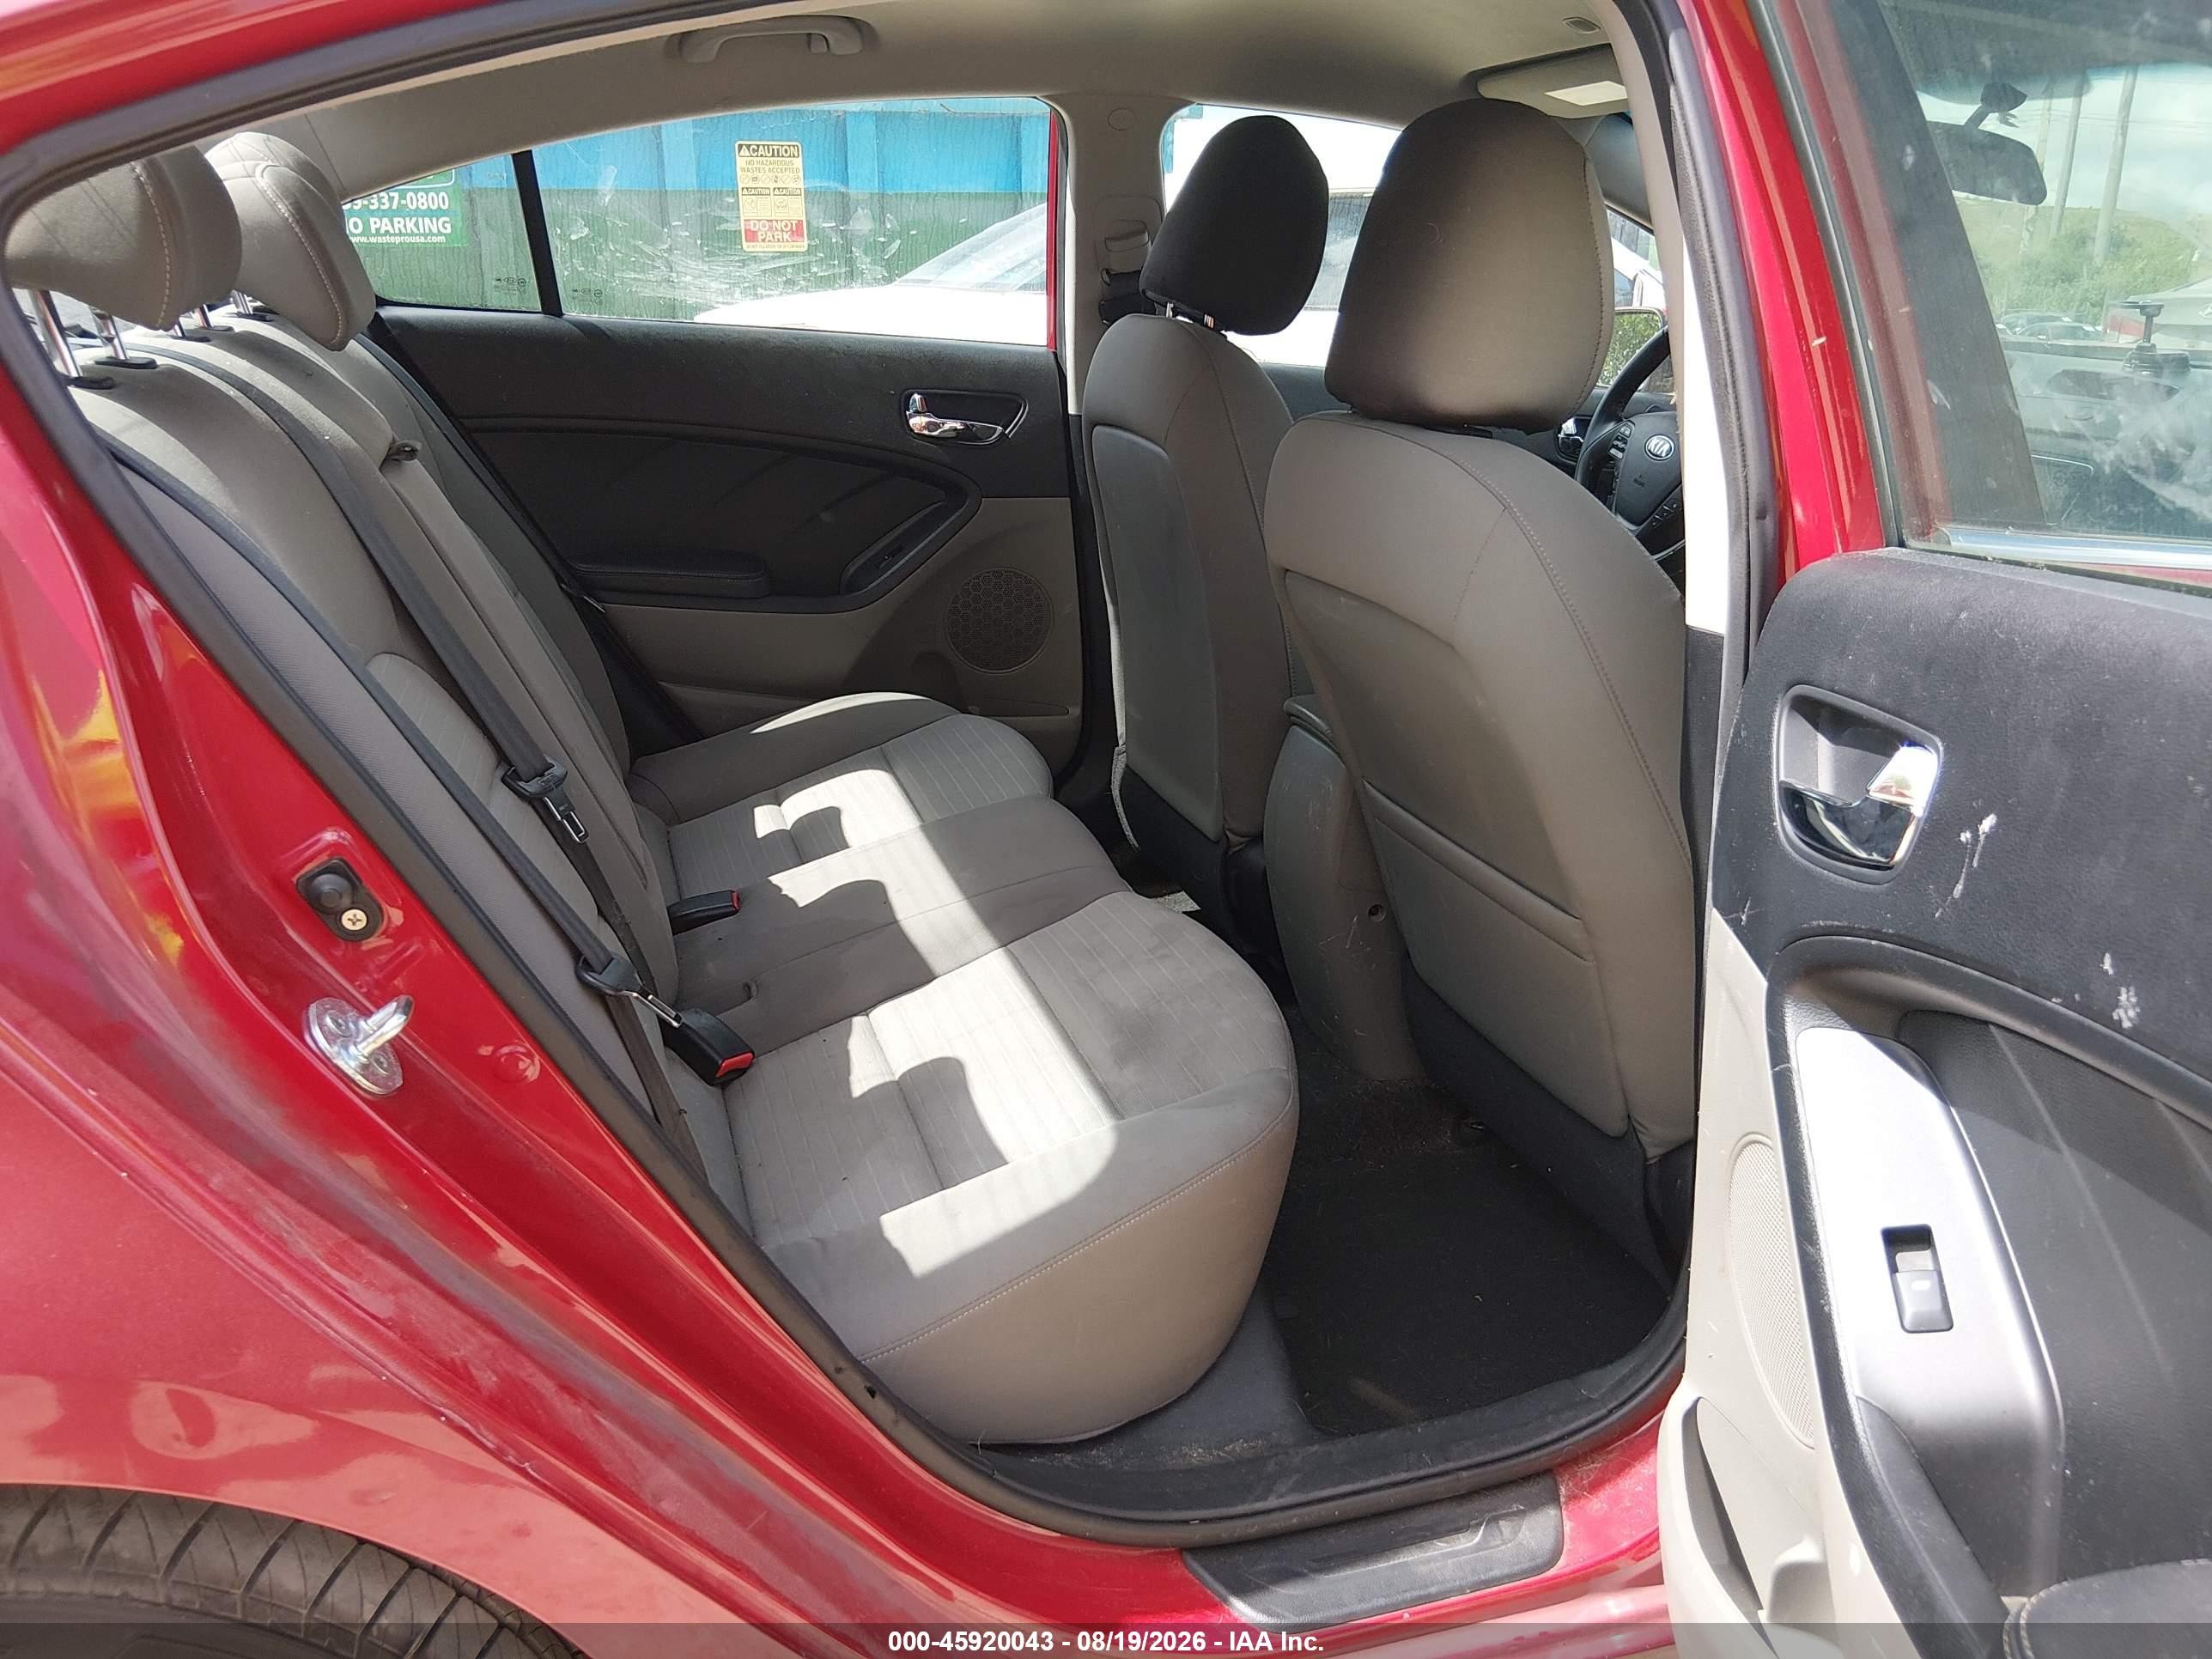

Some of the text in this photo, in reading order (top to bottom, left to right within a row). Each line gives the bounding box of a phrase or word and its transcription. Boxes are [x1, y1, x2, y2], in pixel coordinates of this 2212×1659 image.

[749, 144, 799, 157] CAUTION
[369, 216, 452, 234] PARKING
[750, 220, 798, 232] DO NOT
[757, 231, 793, 242] PARK
